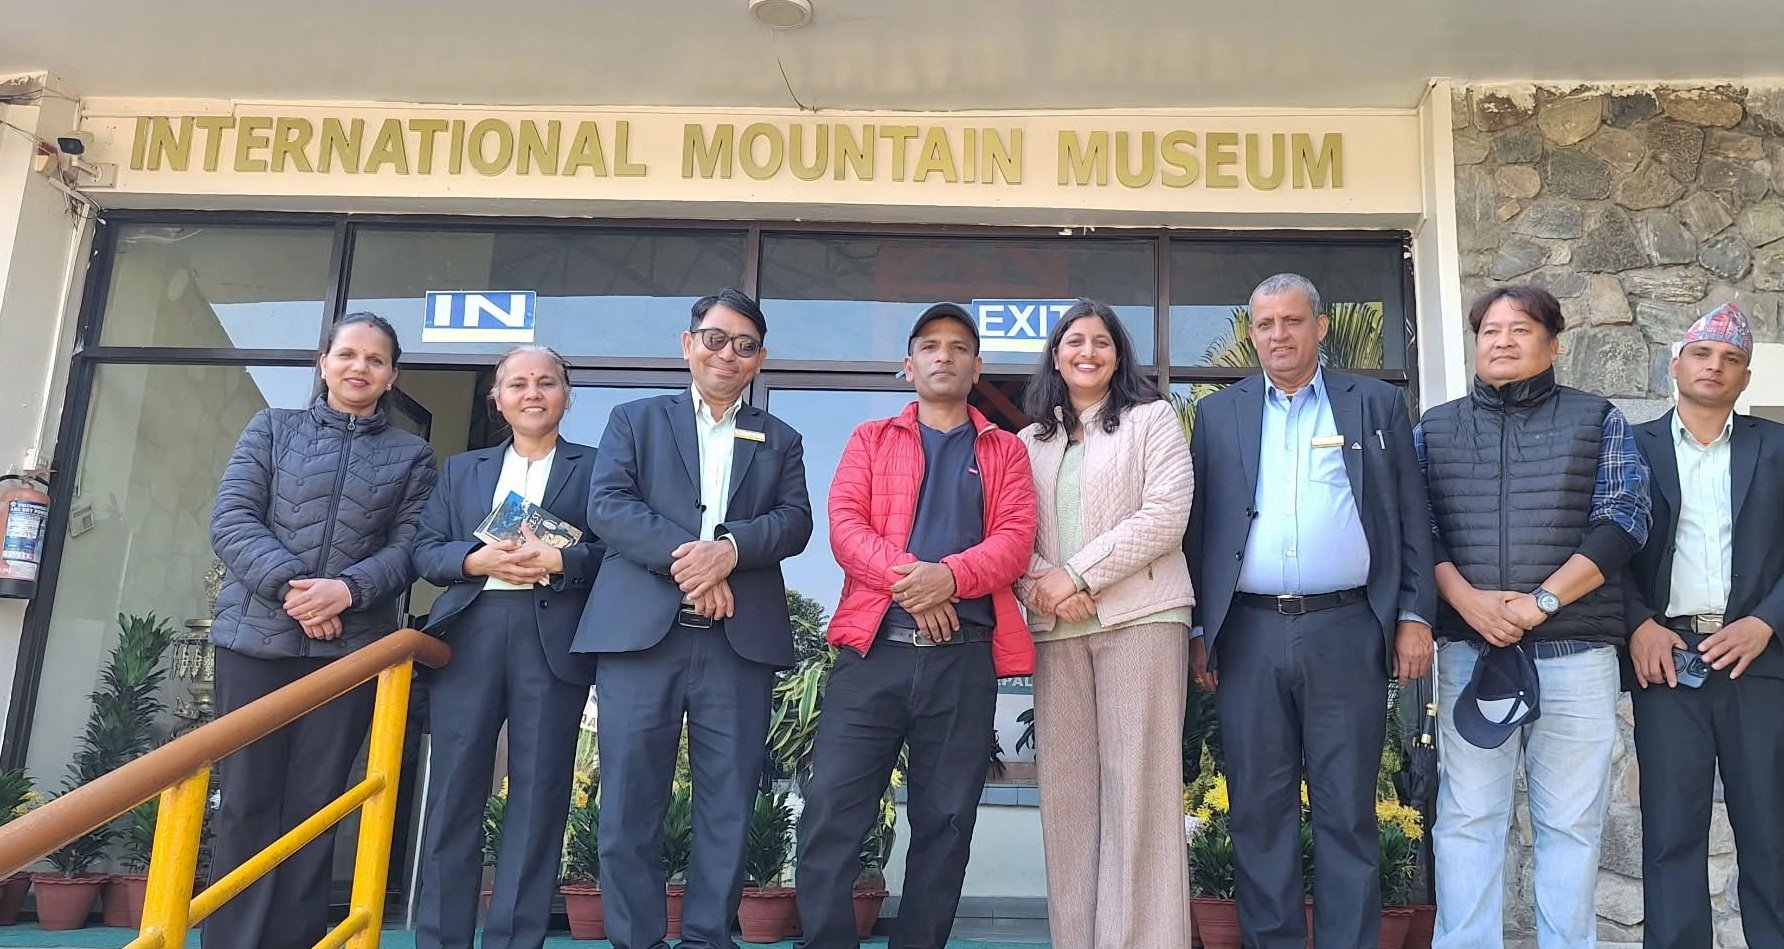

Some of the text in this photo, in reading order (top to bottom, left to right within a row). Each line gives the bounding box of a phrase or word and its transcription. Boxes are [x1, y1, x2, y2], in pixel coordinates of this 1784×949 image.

[131, 115, 1344, 190] INTERNATIONAL MOUNTAIN MUSEUM
[434, 294, 526, 327] IN
[997, 676, 1033, 687] PAL
